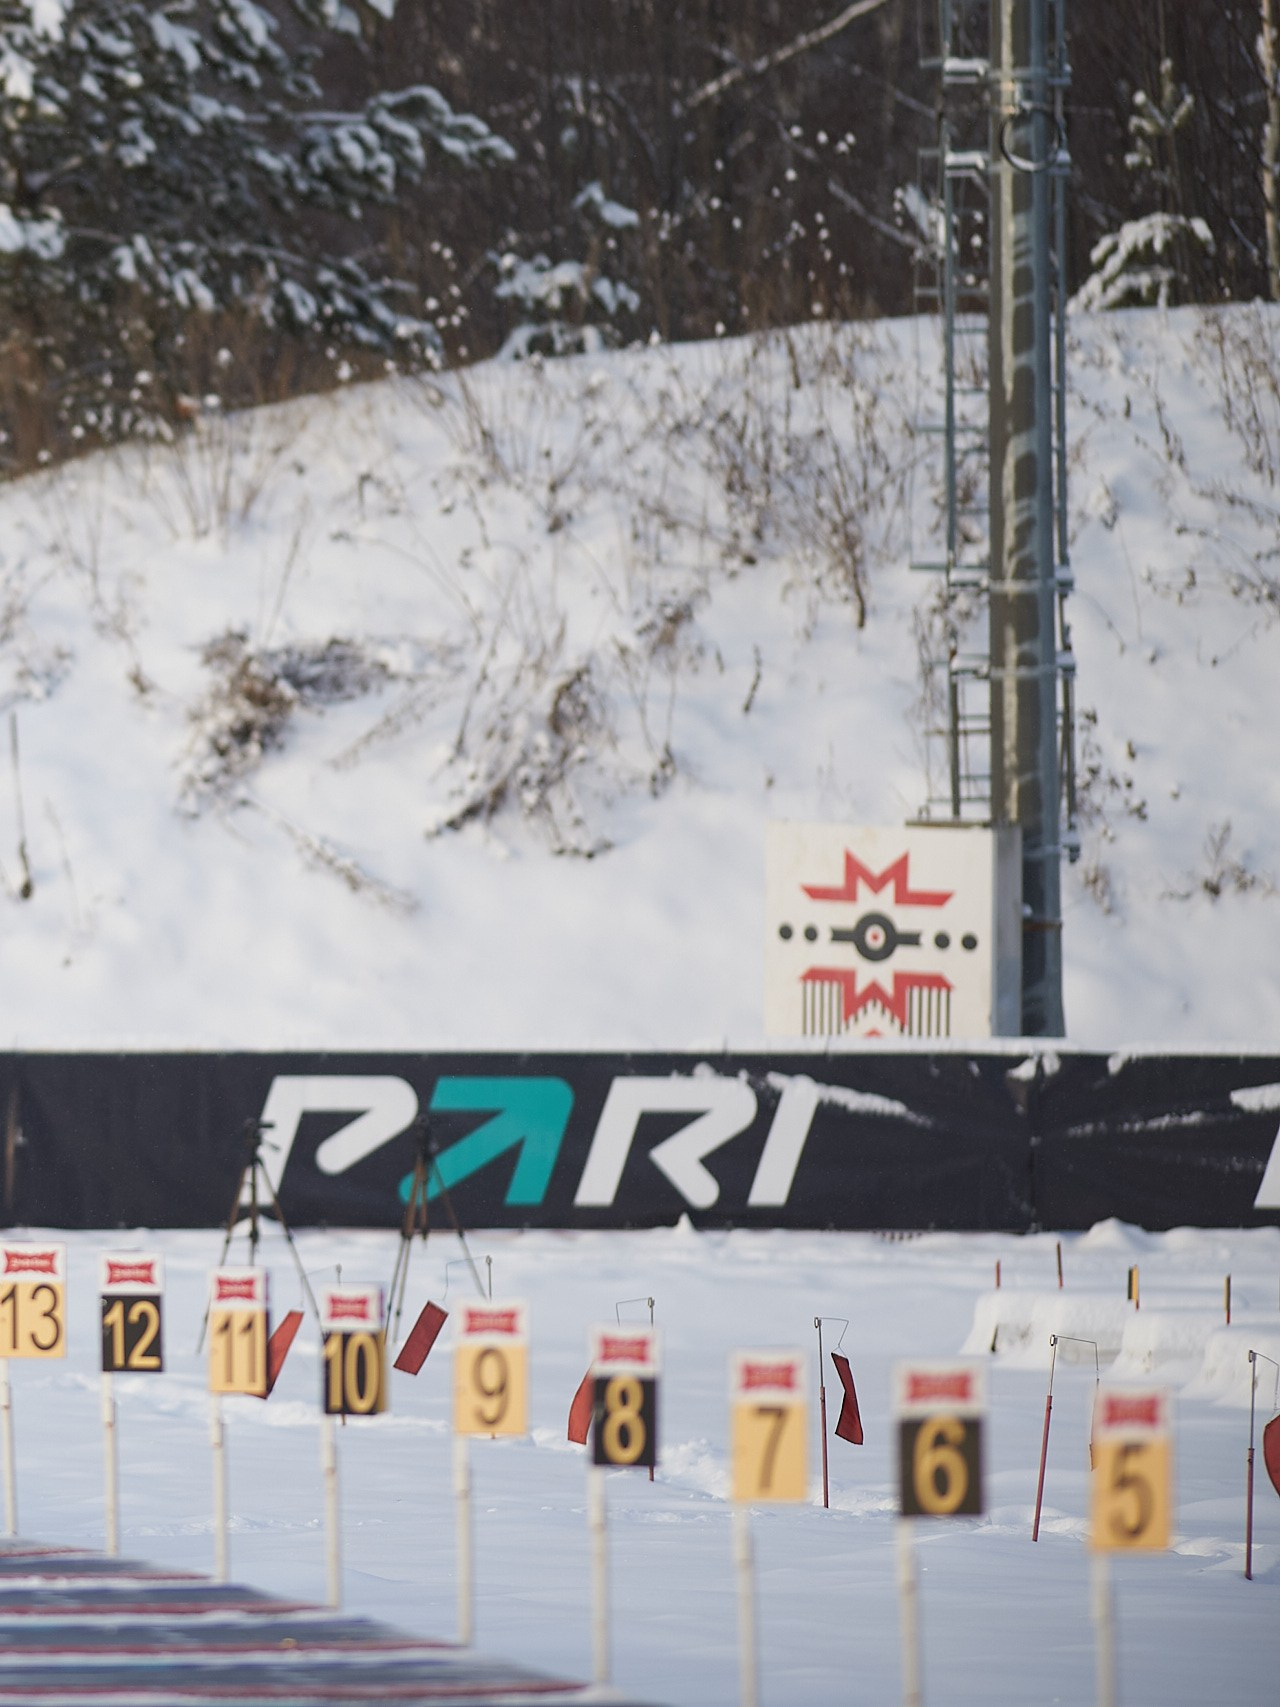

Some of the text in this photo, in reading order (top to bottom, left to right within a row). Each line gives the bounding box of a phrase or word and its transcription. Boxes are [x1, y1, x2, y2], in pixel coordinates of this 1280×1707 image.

[236, 1074, 819, 1209] PARI
[0, 1283, 62, 1351] 13
[103, 1299, 161, 1369] 12
[215, 1312, 257, 1384] 11
[322, 1332, 381, 1414] 10
[471, 1347, 511, 1426] 9
[602, 1376, 647, 1465] 8
[753, 1406, 786, 1492] 7
[913, 1417, 969, 1515] 6
[1108, 1443, 1154, 1540] 5
